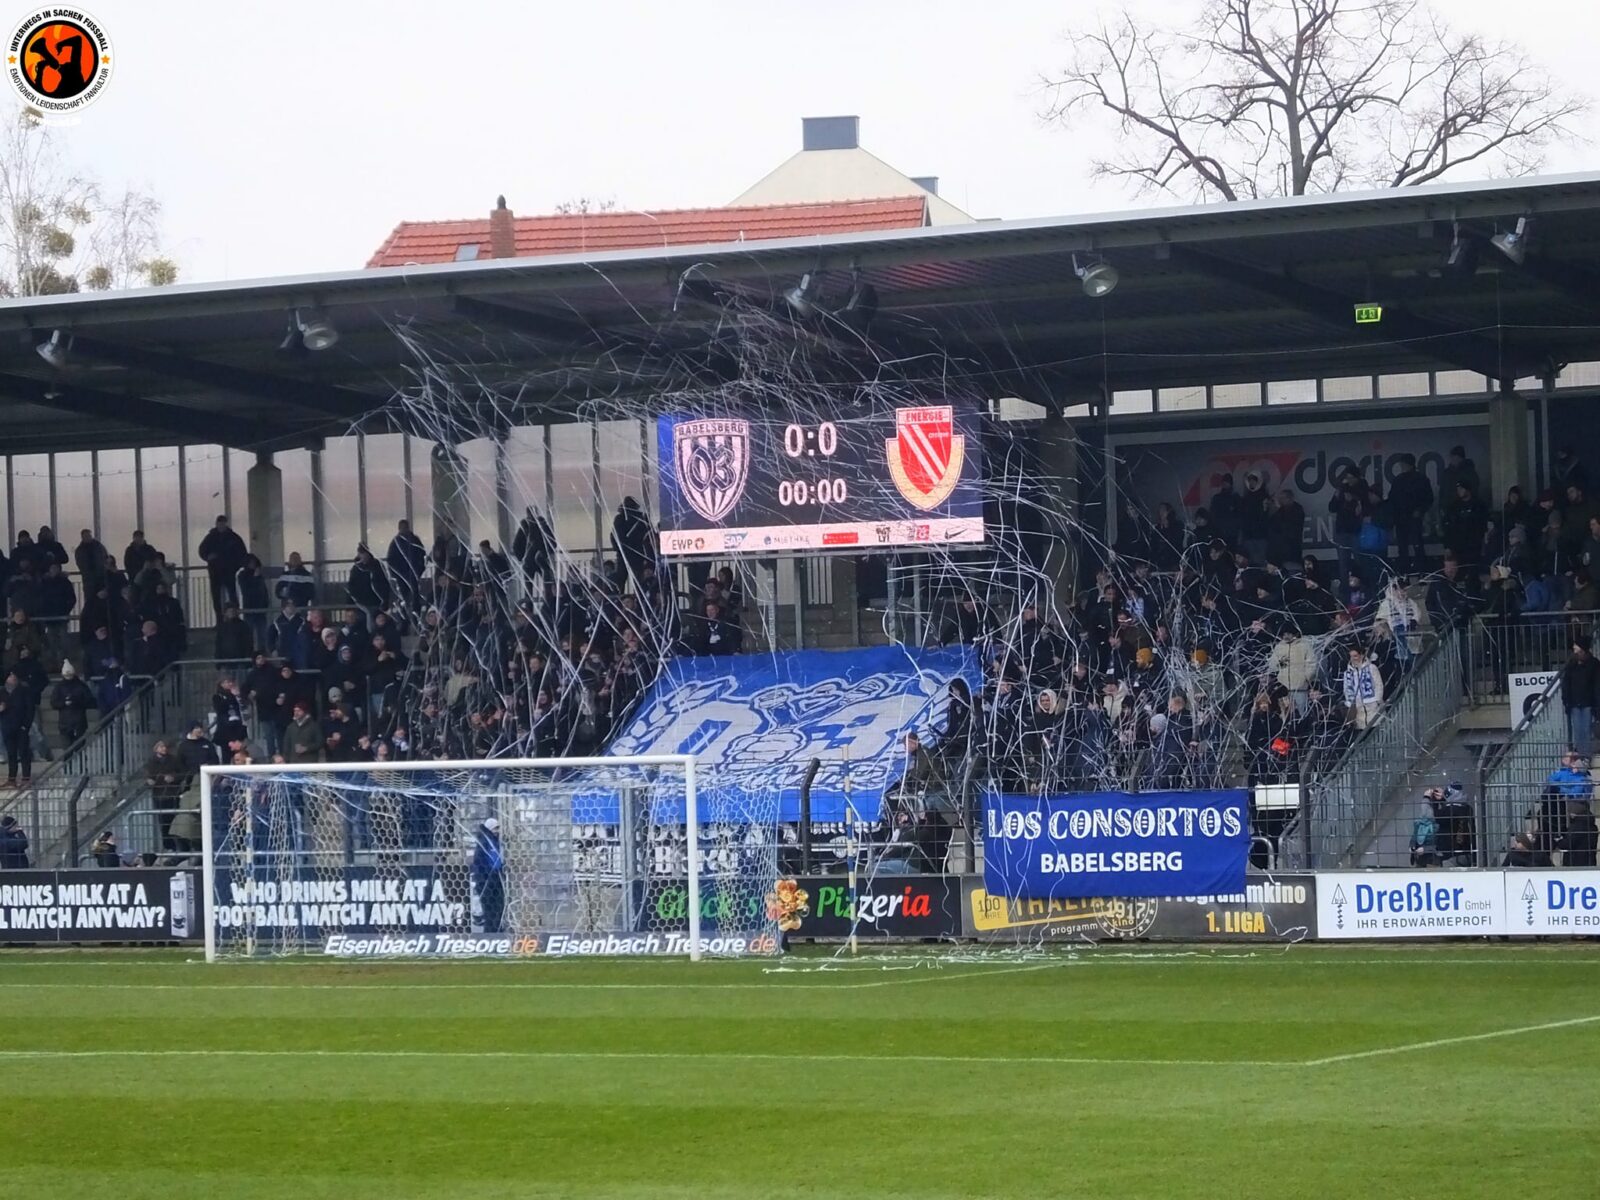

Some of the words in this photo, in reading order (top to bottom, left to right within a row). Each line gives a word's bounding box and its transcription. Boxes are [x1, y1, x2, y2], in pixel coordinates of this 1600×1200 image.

[677, 422, 745, 436] BABELSBERG
[784, 421, 837, 458] 0:0
[686, 444, 738, 493] 03
[778, 478, 848, 507] 00:00
[672, 539, 693, 551] EWP
[1514, 675, 1554, 687] BLOCK
[988, 809, 1042, 840] LOS
[1049, 807, 1242, 840] CONSORTOS
[1040, 851, 1183, 874] BABELSBERG
[0, 884, 54, 906] RINKS
[57, 884, 105, 906] MILK
[106, 883, 131, 905] AT
[133, 883, 147, 905] A
[230, 881, 278, 904] WHO
[281, 880, 347, 902] DRINKS
[350, 879, 400, 902] MILK
[402, 879, 428, 901] AT
[430, 879, 445, 901] A
[1355, 882, 1464, 914] Dreßler
[1464, 900, 1491, 911] GmbH
[1547, 880, 1598, 910] Dre
[213, 905, 298, 927] FOOTBALL
[301, 903, 365, 926] MATCH
[368, 902, 465, 925] ANYWAY?
[656, 888, 759, 919] Glck's
[816, 885, 932, 923] Pizzeria
[11, 906, 72, 929] MATCH
[75, 905, 166, 929] ANYWAY?
[1050, 922, 1098, 936] programm
[1112, 918, 1134, 927] kino
[1206, 911, 1220, 932] 1.
[1224, 911, 1265, 933] LIGA
[1357, 919, 1378, 928] IHR
[1383, 914, 1492, 928] ERDWÄRMEPROFI
[1547, 916, 1569, 926] IHR
[323, 935, 431, 955] Eisenbach
[546, 935, 659, 954] Eisenbach
